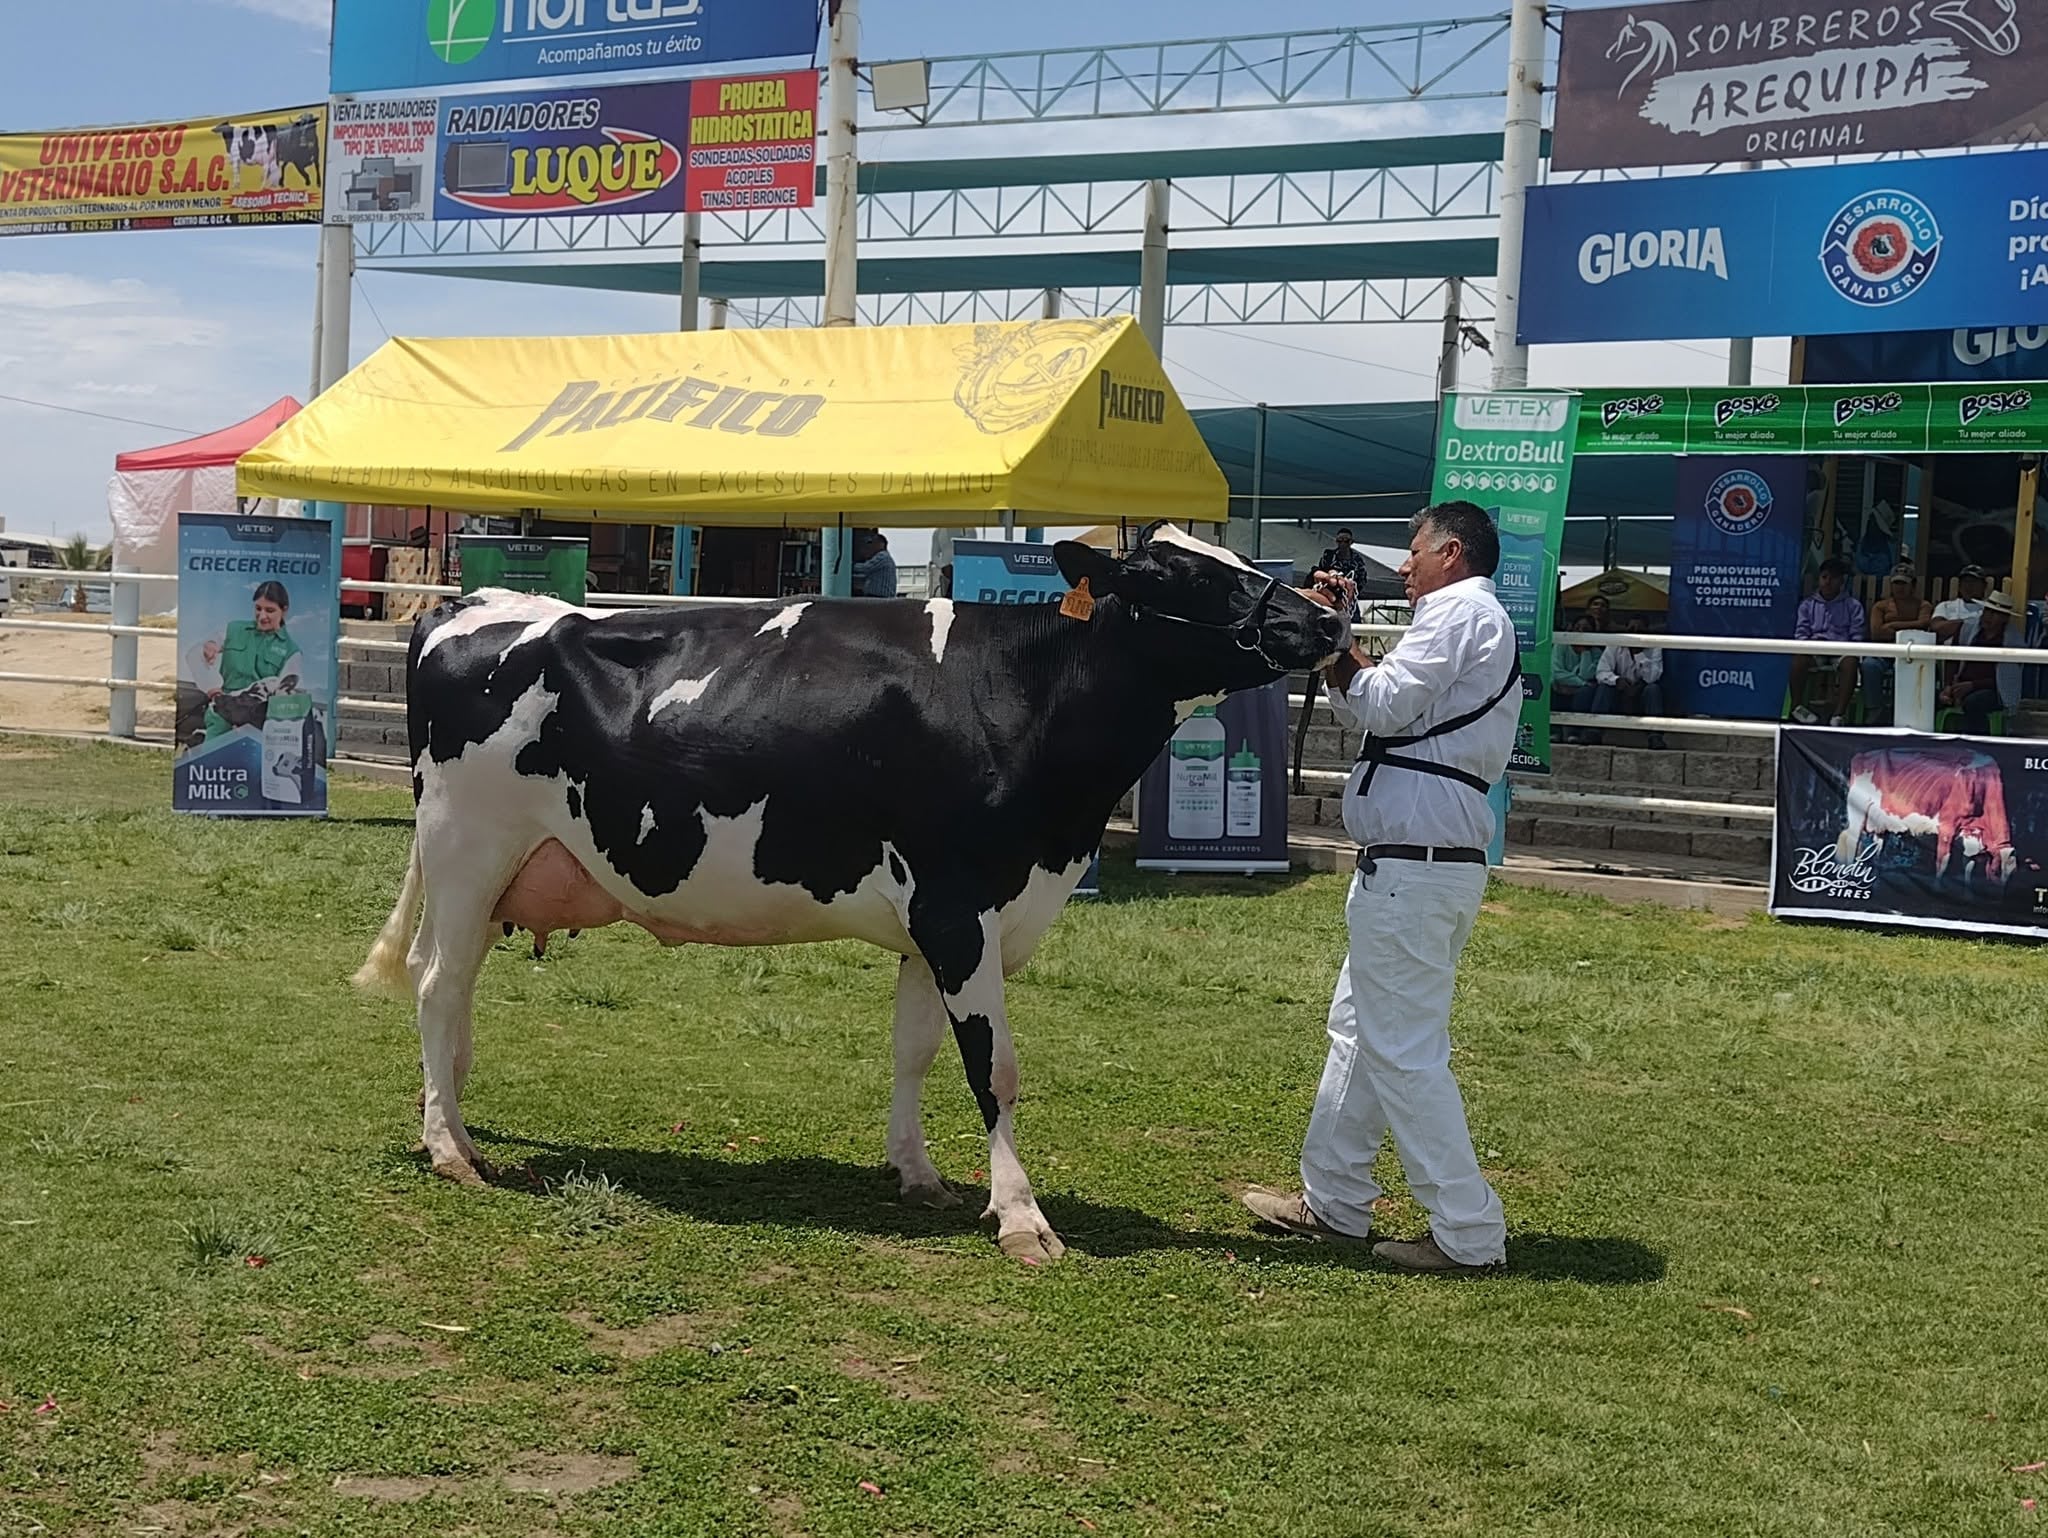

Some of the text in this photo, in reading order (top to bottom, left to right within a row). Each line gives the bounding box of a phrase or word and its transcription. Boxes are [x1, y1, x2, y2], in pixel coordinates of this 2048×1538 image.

[1686, 1, 1923, 58] SOMBREROS
[537, 35, 701, 64] Acompañamos tu éxito
[720, 79, 786, 111] PRUEBA
[1691, 55, 1929, 125] AREQUIPA
[333, 99, 437, 121] VENTA DE RADIADORES
[445, 99, 600, 135] RADIADORES
[333, 120, 435, 139] IMPORTADOS PARA TODO
[690, 110, 813, 145] HIDROSTATICA
[40, 125, 188, 166] UNIVERSO
[343, 140, 362, 155] TIPO
[364, 140, 375, 154] DE
[1746, 123, 1865, 153] ORIGINAL
[0, 155, 229, 203] VETERINARIO S.A.C.
[509, 139, 662, 204] LUQUE
[725, 168, 774, 186] ACOPLES
[158, 199, 185, 209] MAYOR
[192, 197, 221, 208] MENOR
[702, 188, 797, 208] TINAS DE BRONCE
[1834, 197, 1931, 240] DESARROLLO
[1577, 226, 1729, 285] GLORIA
[1832, 262, 1925, 299] GANADERO
[1098, 369, 1165, 429] PACIFICO
[1471, 399, 1553, 417] VETEX
[1750, 430, 1775, 439] aliado
[1870, 429, 1897, 439] aliado
[1999, 429, 2026, 438] aliado
[1445, 438, 1565, 463] DextroBull
[649, 469, 679, 492] EN
[827, 471, 858, 493] ES
[1713, 474, 1767, 500] DESARROLLO
[237, 524, 274, 533] VETEX
[1507, 513, 1540, 524] VETEX
[1711, 510, 1763, 531] GANADERO
[189, 556, 320, 575] CRECER RECIO
[1014, 554, 1053, 564] VETEX
[1502, 573, 1530, 587] BULL
[1687, 576, 1780, 586] UNA GANADERÍA
[1694, 566, 1777, 576] PROMOVEMOS
[1695, 586, 1772, 597] COMPETITIVA
[1695, 597, 1771, 607] Y SOSTENIBLE
[1699, 669, 1754, 691] GLORIA
[188, 764, 248, 782] Nutra
[188, 784, 231, 800] Milk
[1793, 838, 1883, 883] Blondin
[1827, 888, 1871, 900] SIRES
